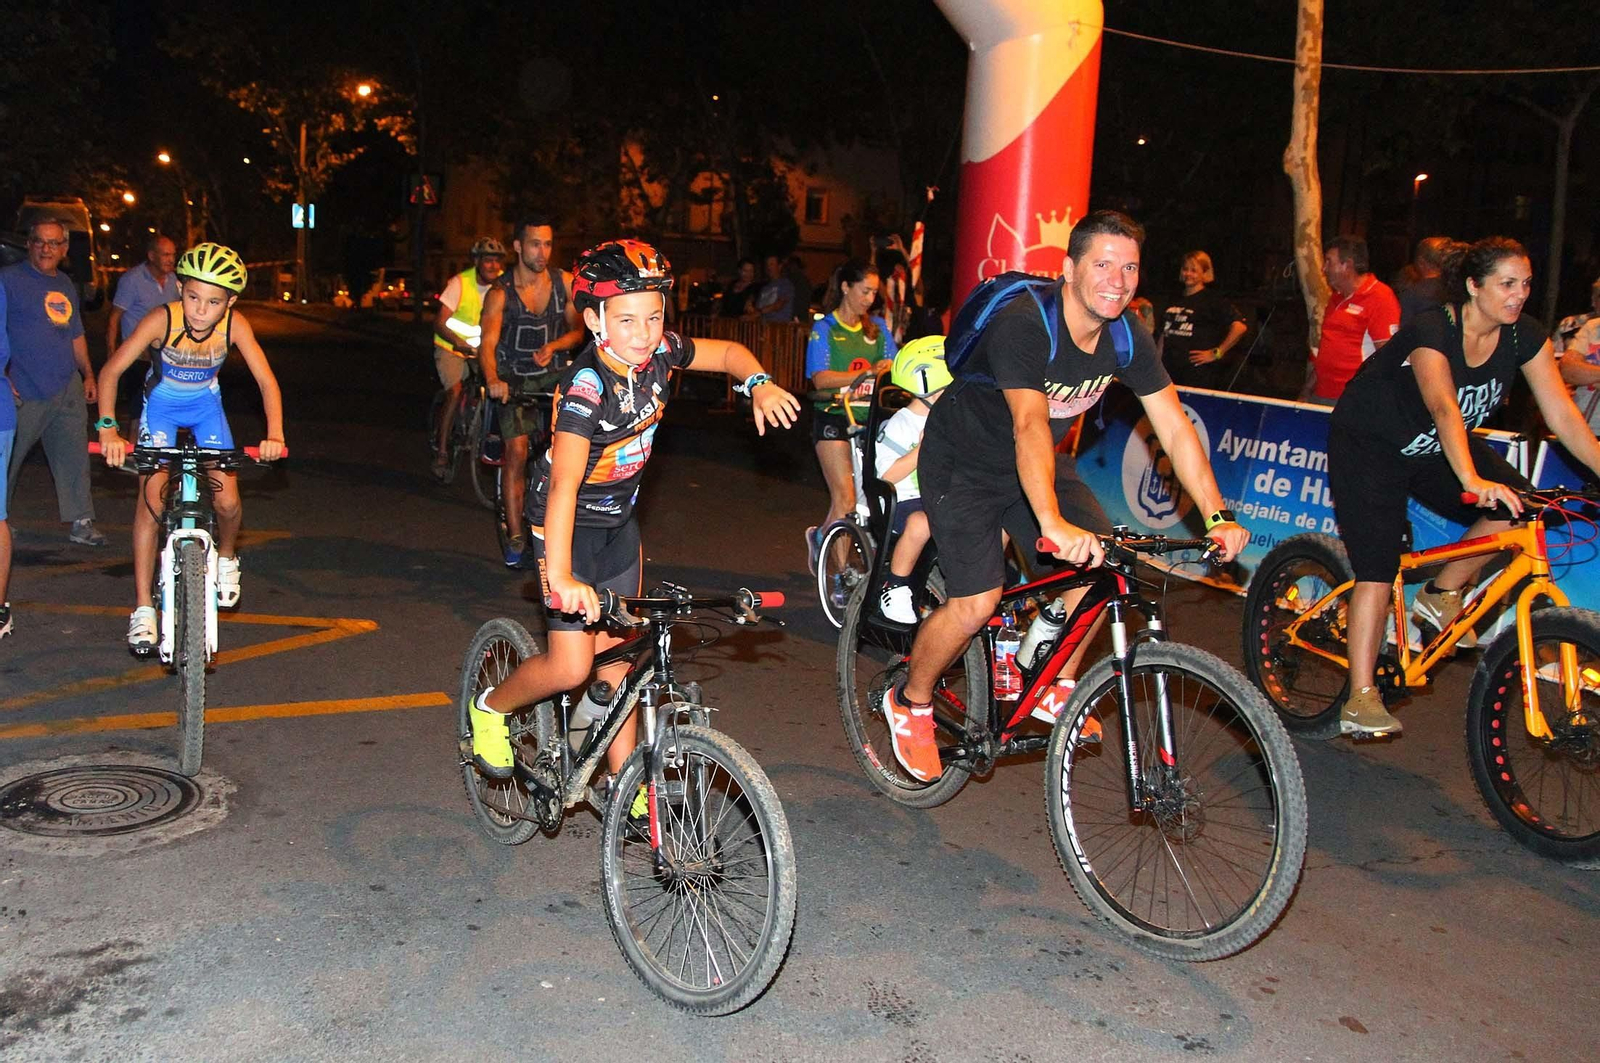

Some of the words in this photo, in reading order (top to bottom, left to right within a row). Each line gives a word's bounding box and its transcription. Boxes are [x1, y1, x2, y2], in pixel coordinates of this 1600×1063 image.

[167, 368, 204, 380] ALBERTO
[1217, 428, 1329, 473] Ayuntam
[1254, 468, 1292, 497] de
[1295, 513, 1317, 529] de
[894, 712, 912, 737] N
